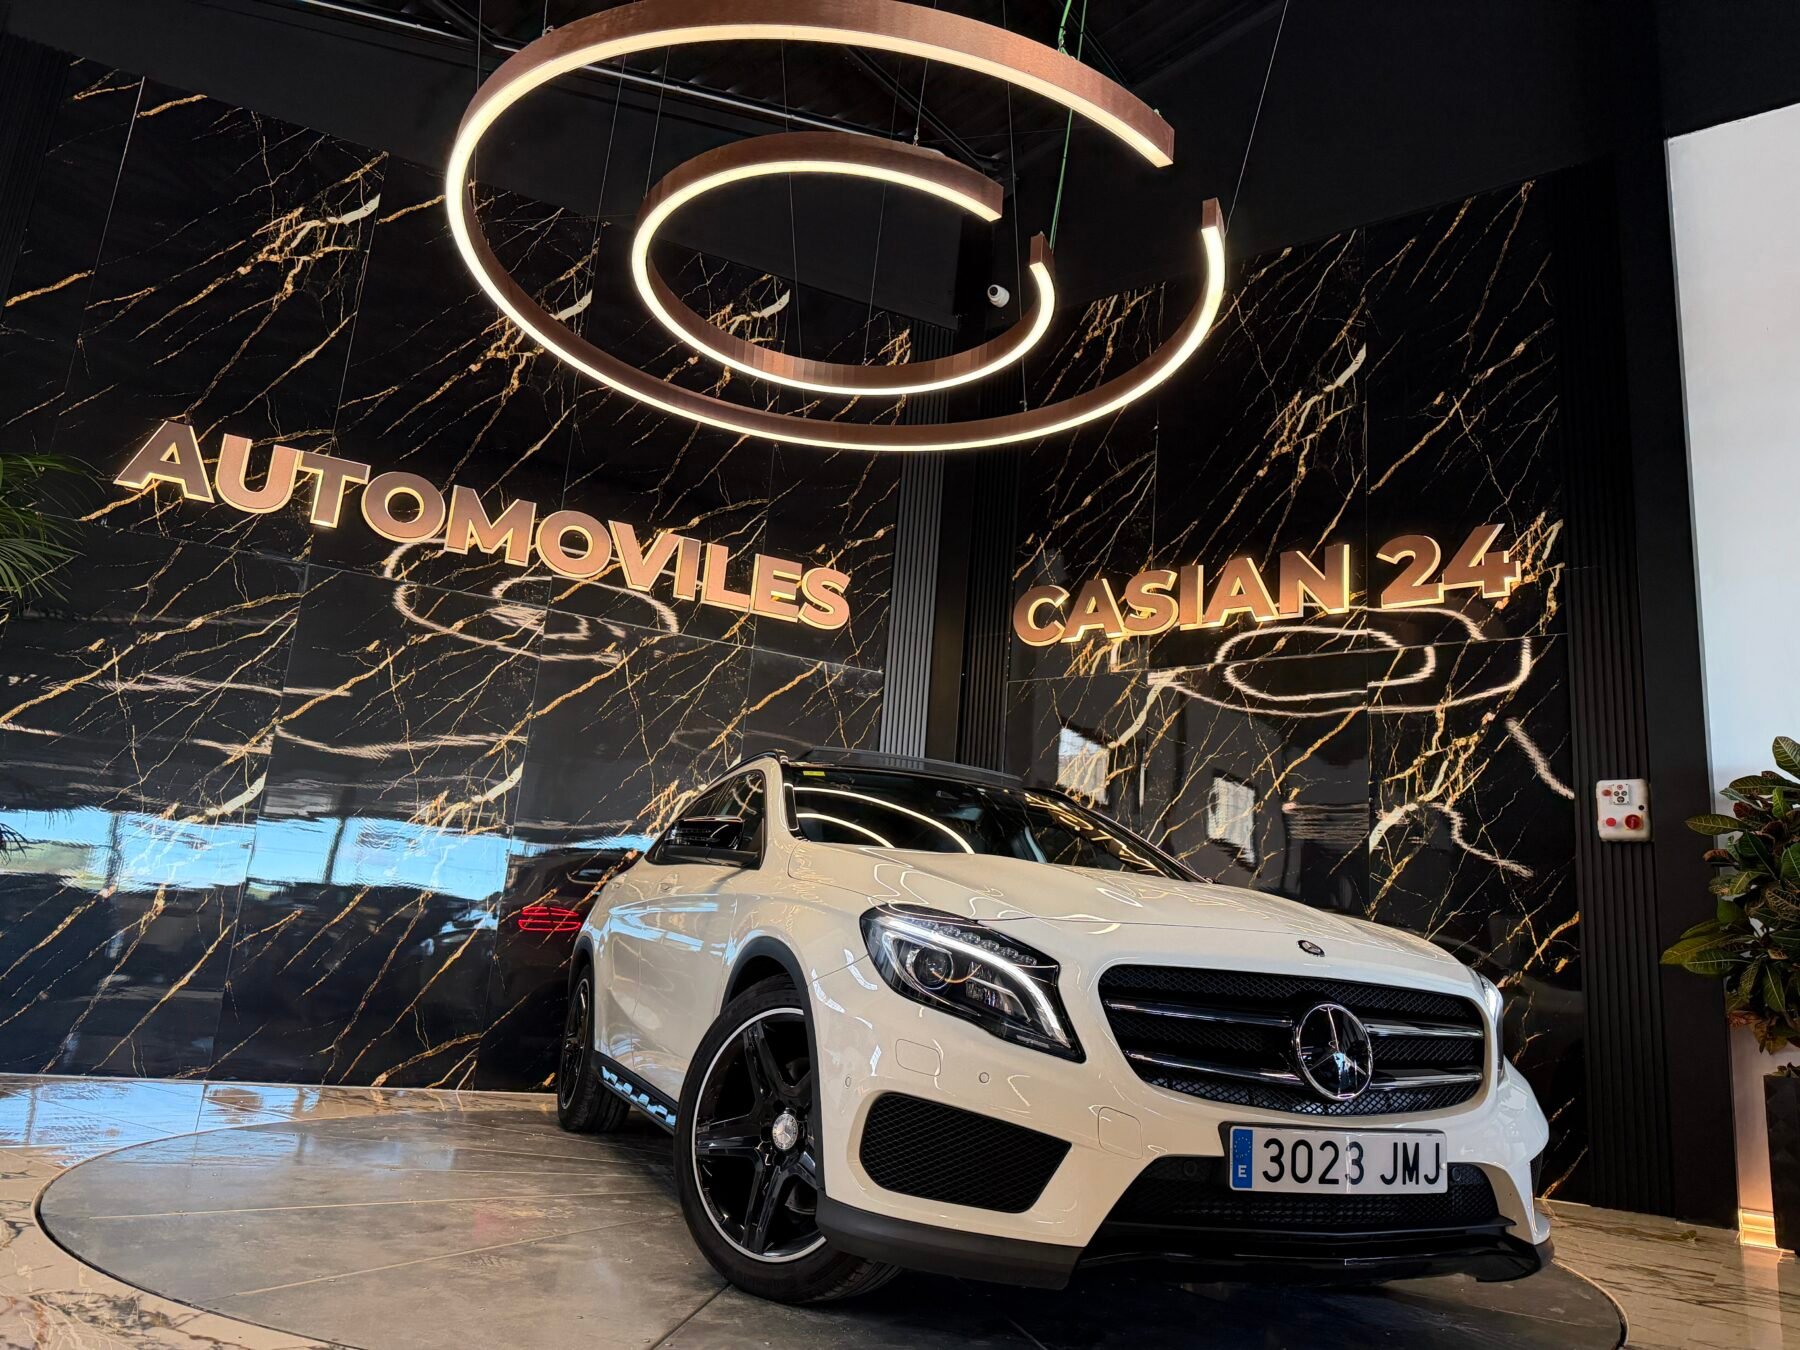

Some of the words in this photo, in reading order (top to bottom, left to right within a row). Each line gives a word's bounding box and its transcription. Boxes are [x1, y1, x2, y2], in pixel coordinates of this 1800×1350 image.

[113, 420, 850, 630] AUTOMOVILES
[1012, 544, 1351, 646] CASIAN
[1376, 523, 1521, 609] 24
[1238, 1165, 1247, 1178] E
[1262, 1138, 1364, 1185] 3023
[1380, 1142, 1440, 1185] JMJ
